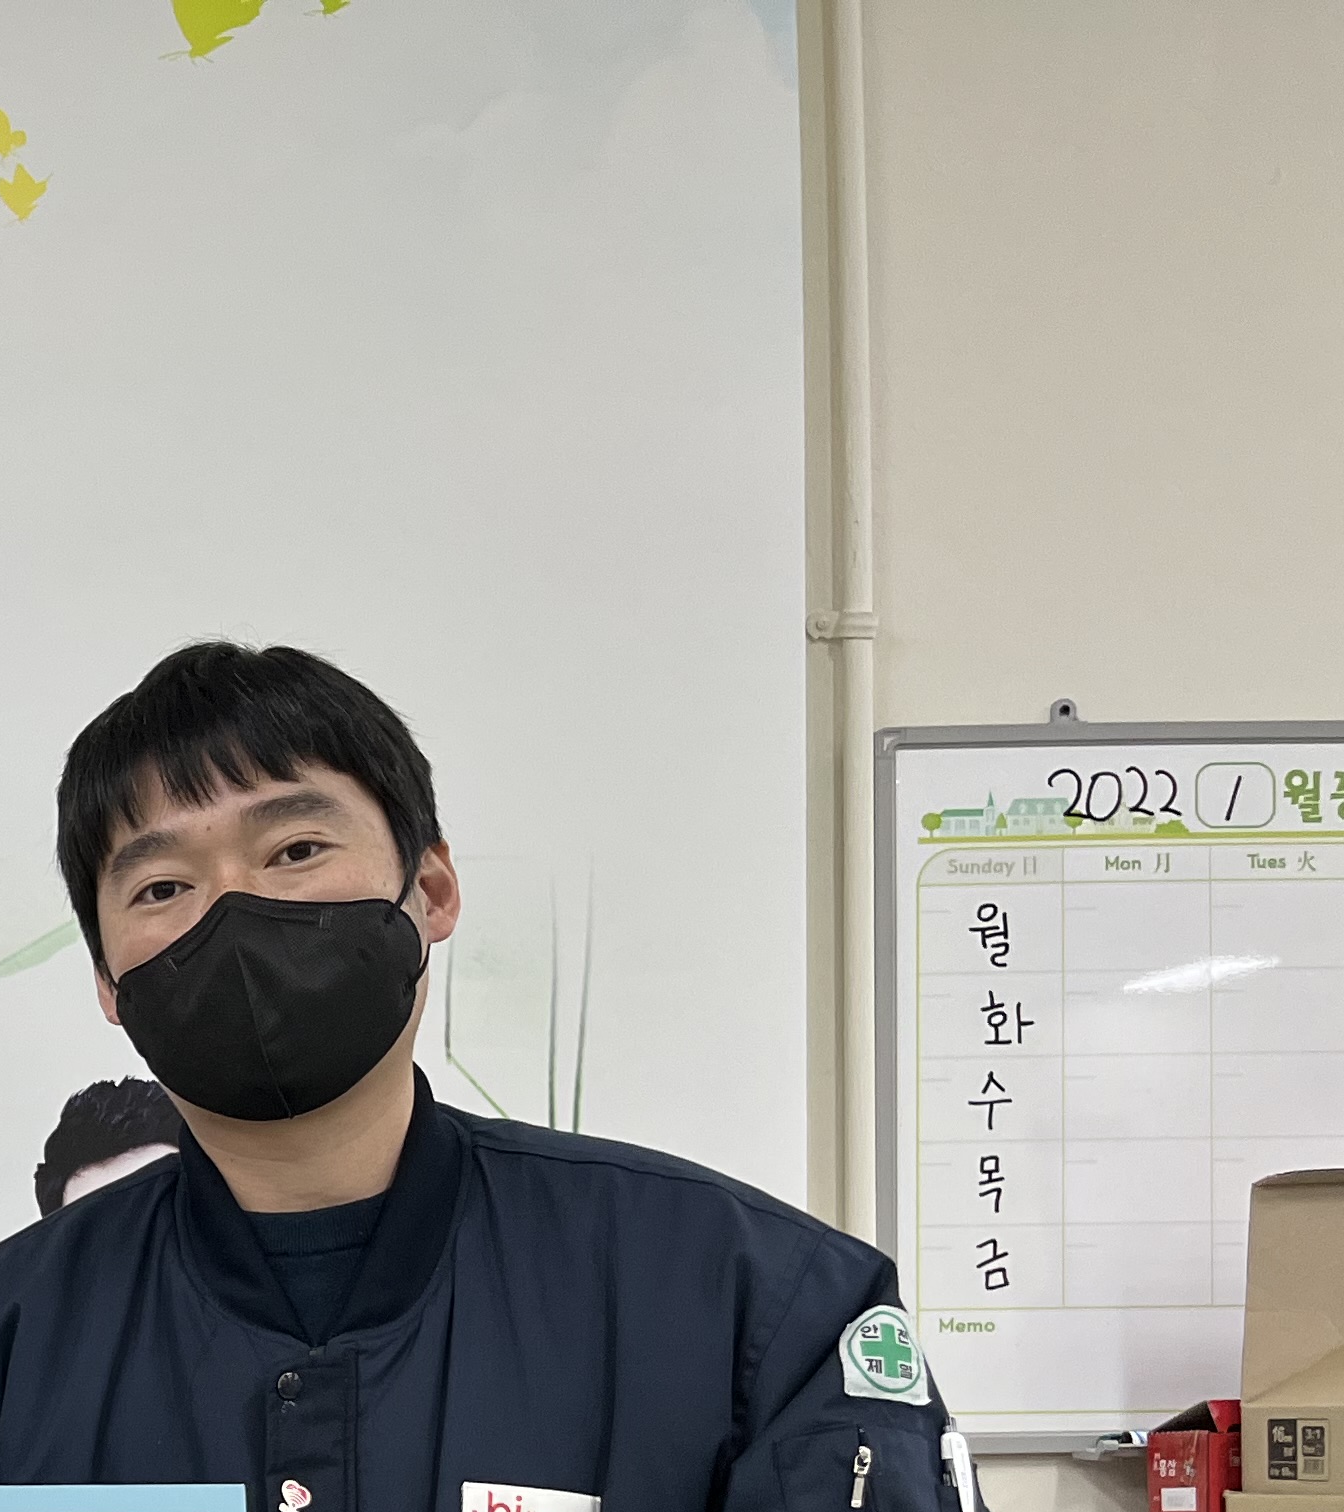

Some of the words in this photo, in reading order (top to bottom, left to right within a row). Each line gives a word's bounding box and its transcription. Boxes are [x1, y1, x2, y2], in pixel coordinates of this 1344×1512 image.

[1048, 766, 1183, 823] 2022
[947, 857, 1015, 877] Sunday
[1104, 855, 1142, 872] Mon
[1154, 852, 1171, 874] 月
[1246, 852, 1287, 870] Tues
[1297, 850, 1317, 872] 火
[968, 903, 1010, 968] 월
[981, 990, 1035, 1045] 화
[968, 1071, 1013, 1130] 수
[978, 1155, 1005, 1214] 목
[975, 1239, 1010, 1291] 금
[938, 1317, 996, 1333] Memo
